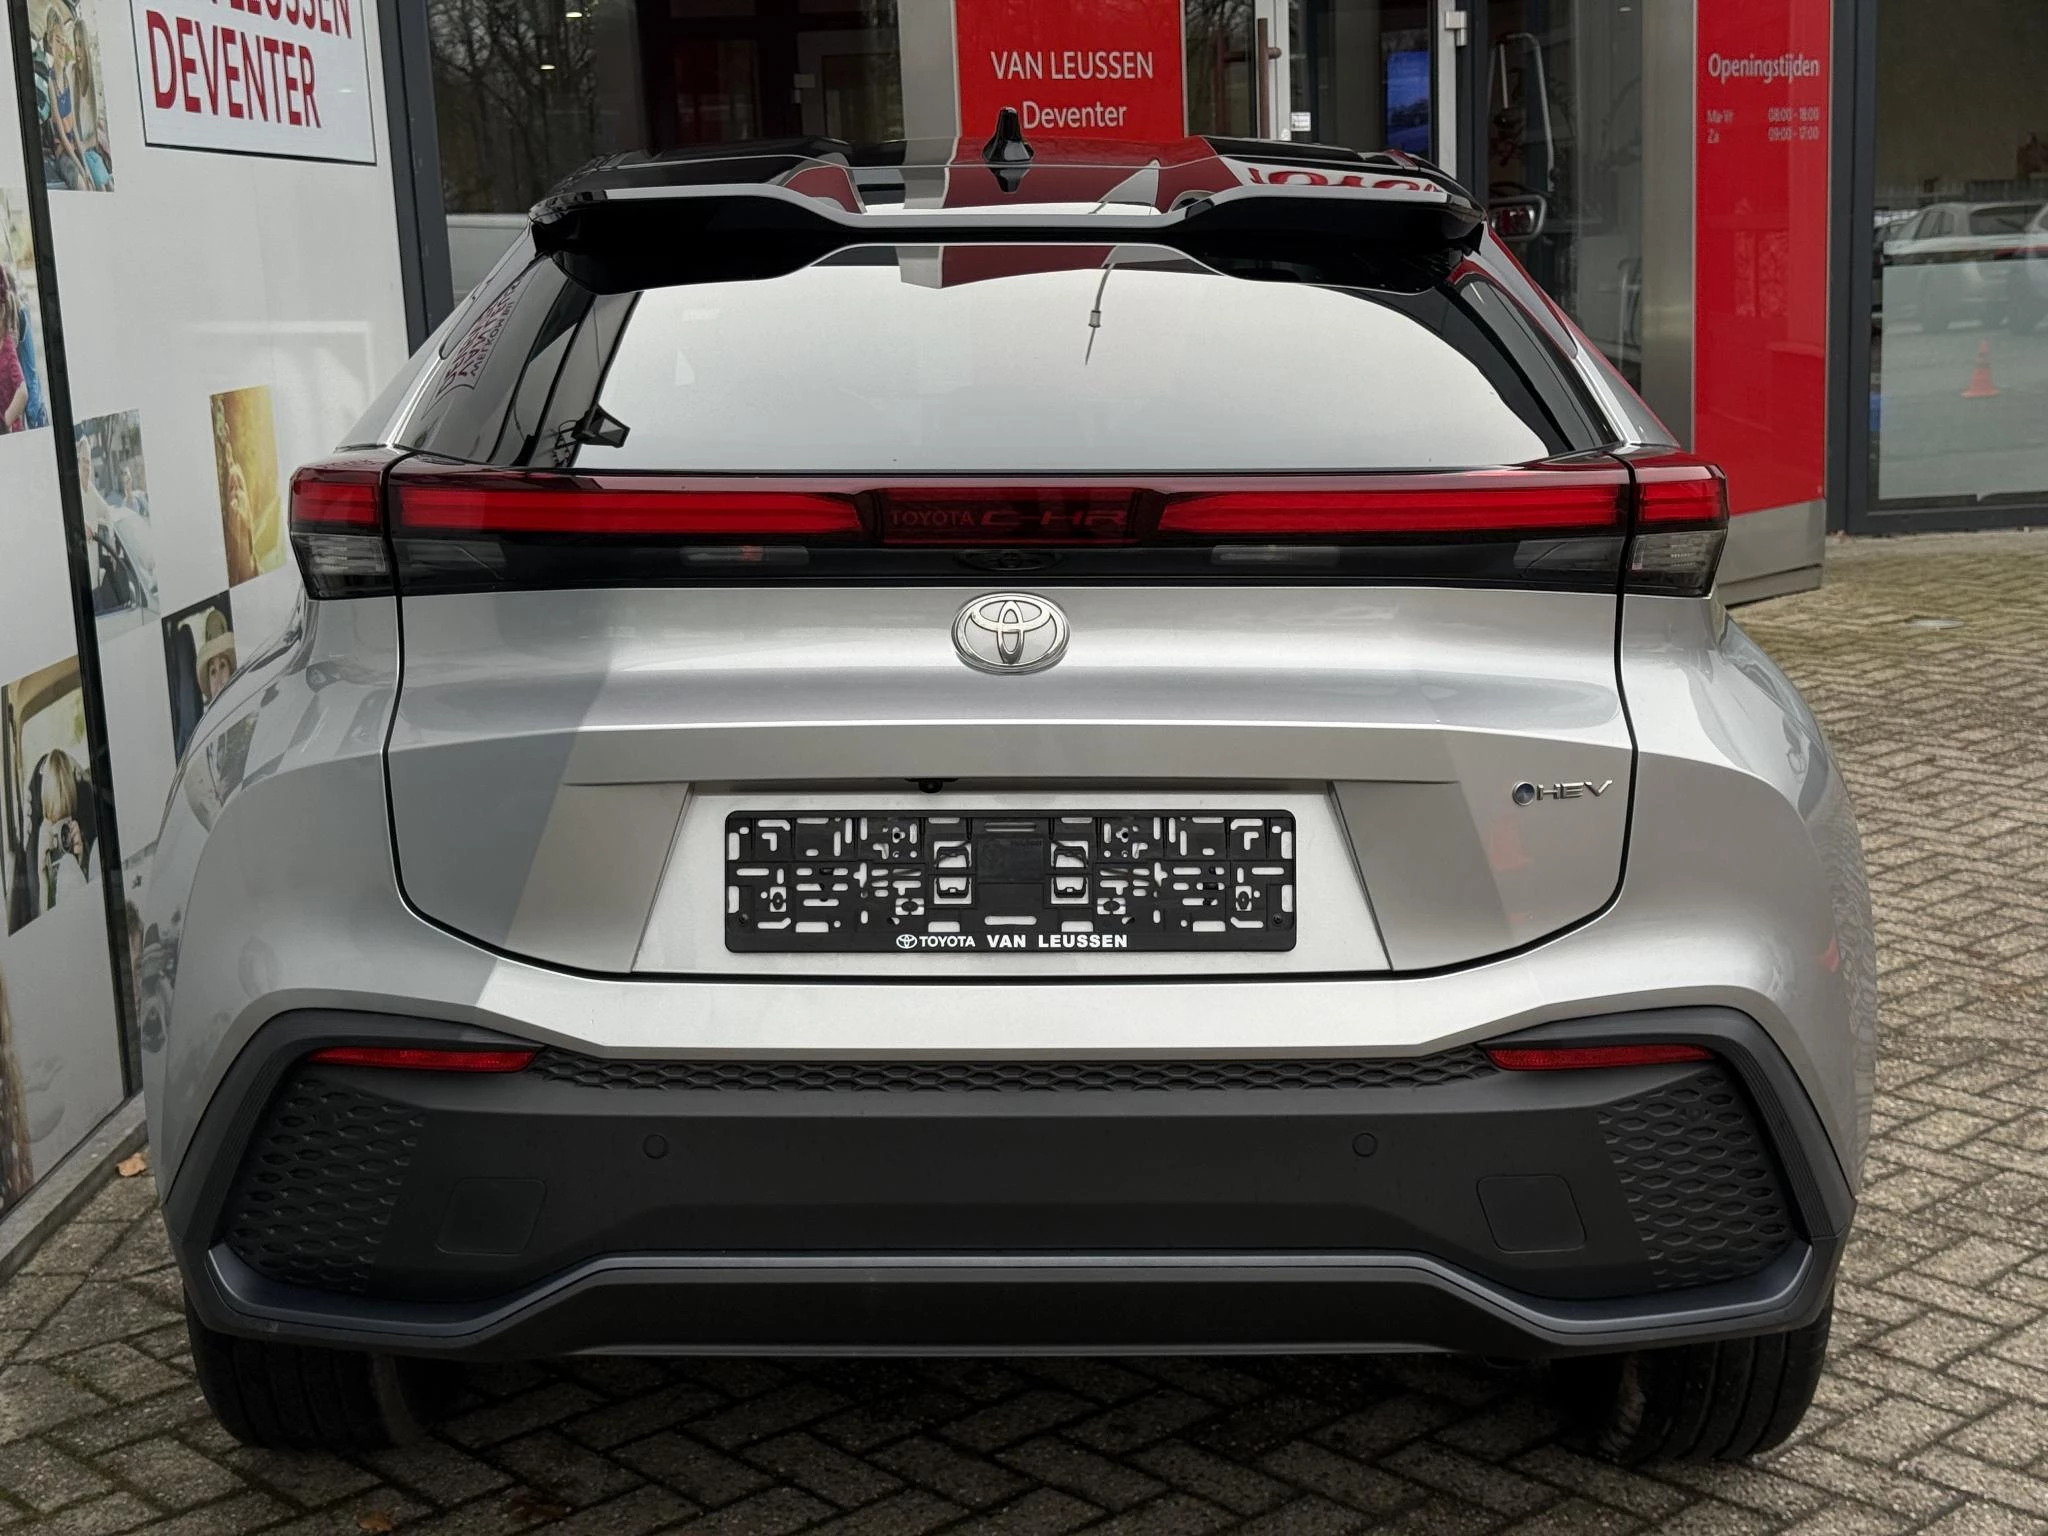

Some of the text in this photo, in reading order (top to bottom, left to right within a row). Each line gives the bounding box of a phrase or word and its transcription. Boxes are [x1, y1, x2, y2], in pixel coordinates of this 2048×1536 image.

[146, 9, 321, 129] DEVENTER
[990, 50, 1153, 80] VAN LEUSSEN
[1708, 52, 1820, 84] Openingstijden
[1022, 100, 1127, 129] Deventer
[893, 510, 1127, 526] TOYOTA C-HR
[1536, 780, 1613, 801] HEV
[919, 934, 1128, 948] TOYOTA VAN LEUSSEN
